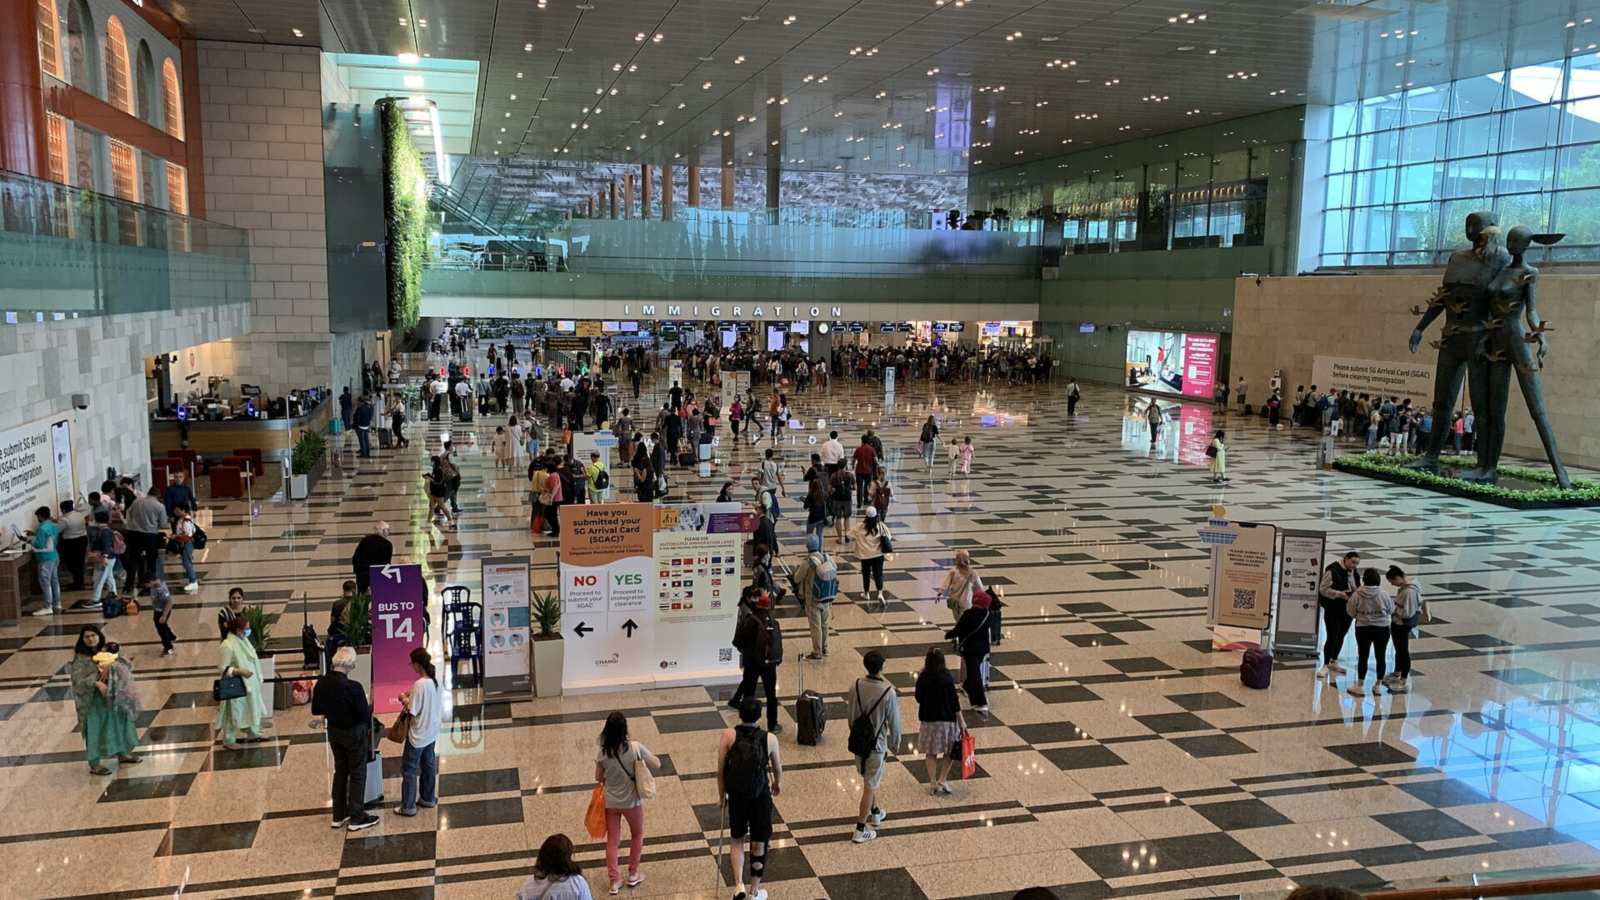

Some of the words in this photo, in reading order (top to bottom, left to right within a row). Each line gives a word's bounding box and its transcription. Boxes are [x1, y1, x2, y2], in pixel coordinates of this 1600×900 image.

[624, 304, 842, 317] IMMIGRATION
[1377, 367, 1396, 375] Arrival
[1397, 368, 1409, 376] Card
[3, 441, 22, 457] submit
[23, 436, 30, 450] SG
[31, 432, 47, 447] Arrival
[19, 453, 35, 468] before
[11, 465, 42, 487] immigration
[573, 518, 619, 526] submitted
[621, 518, 641, 526] your
[620, 526, 641, 534] Card
[589, 535, 625, 545] (SGAC)?
[574, 575, 597, 587] NO
[614, 574, 643, 586] YES
[378, 602, 399, 612] BUS
[400, 601, 415, 610] TO
[378, 613, 415, 642] T4
